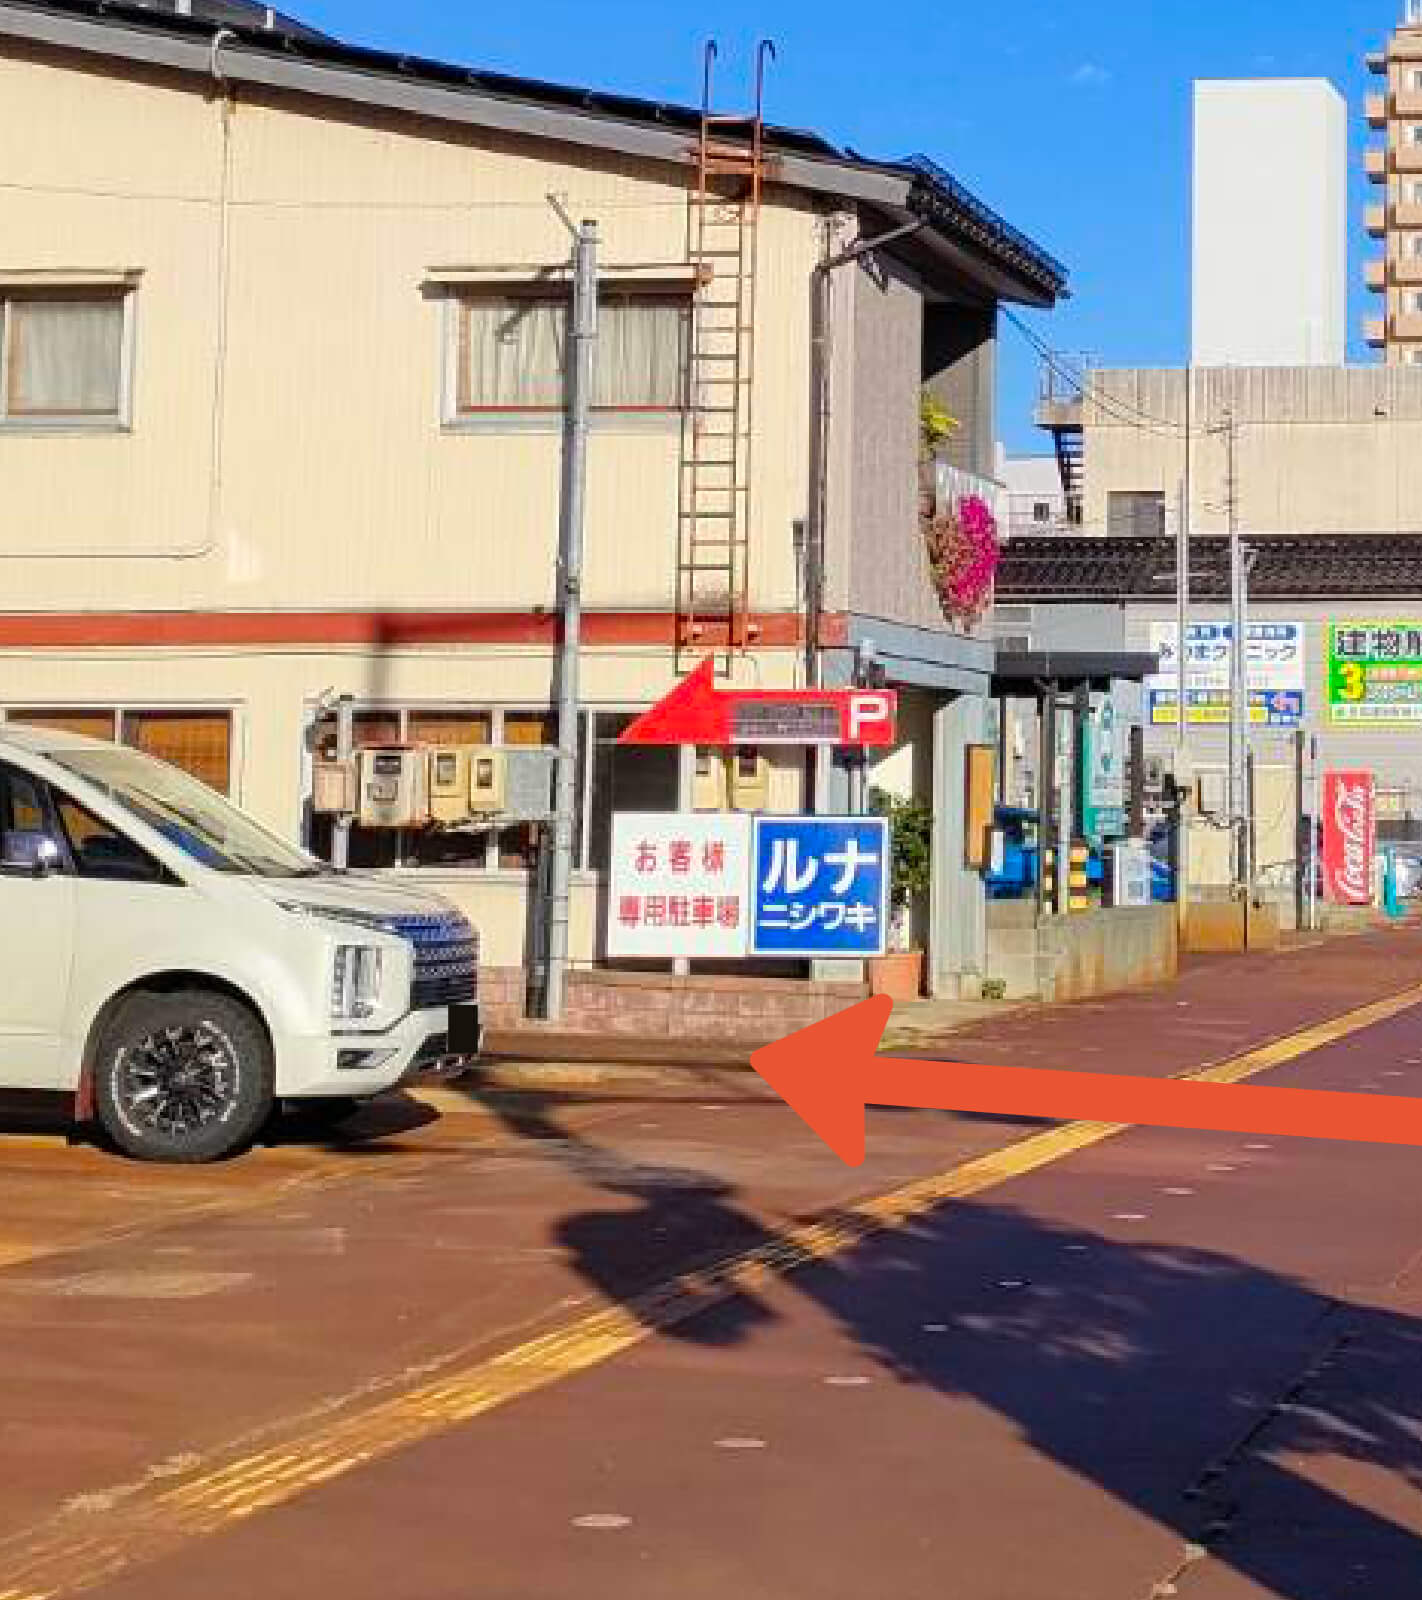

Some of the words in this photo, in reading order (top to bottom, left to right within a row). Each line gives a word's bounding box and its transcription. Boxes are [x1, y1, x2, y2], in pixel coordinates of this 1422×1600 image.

[1337, 661, 1365, 700] 3
[848, 696, 888, 739] P
[633, 839, 726, 875] お客様
[761, 838, 878, 896] ルナ
[616, 894, 741, 929] 専用駐車場
[758, 902, 878, 934] ニシワキ
